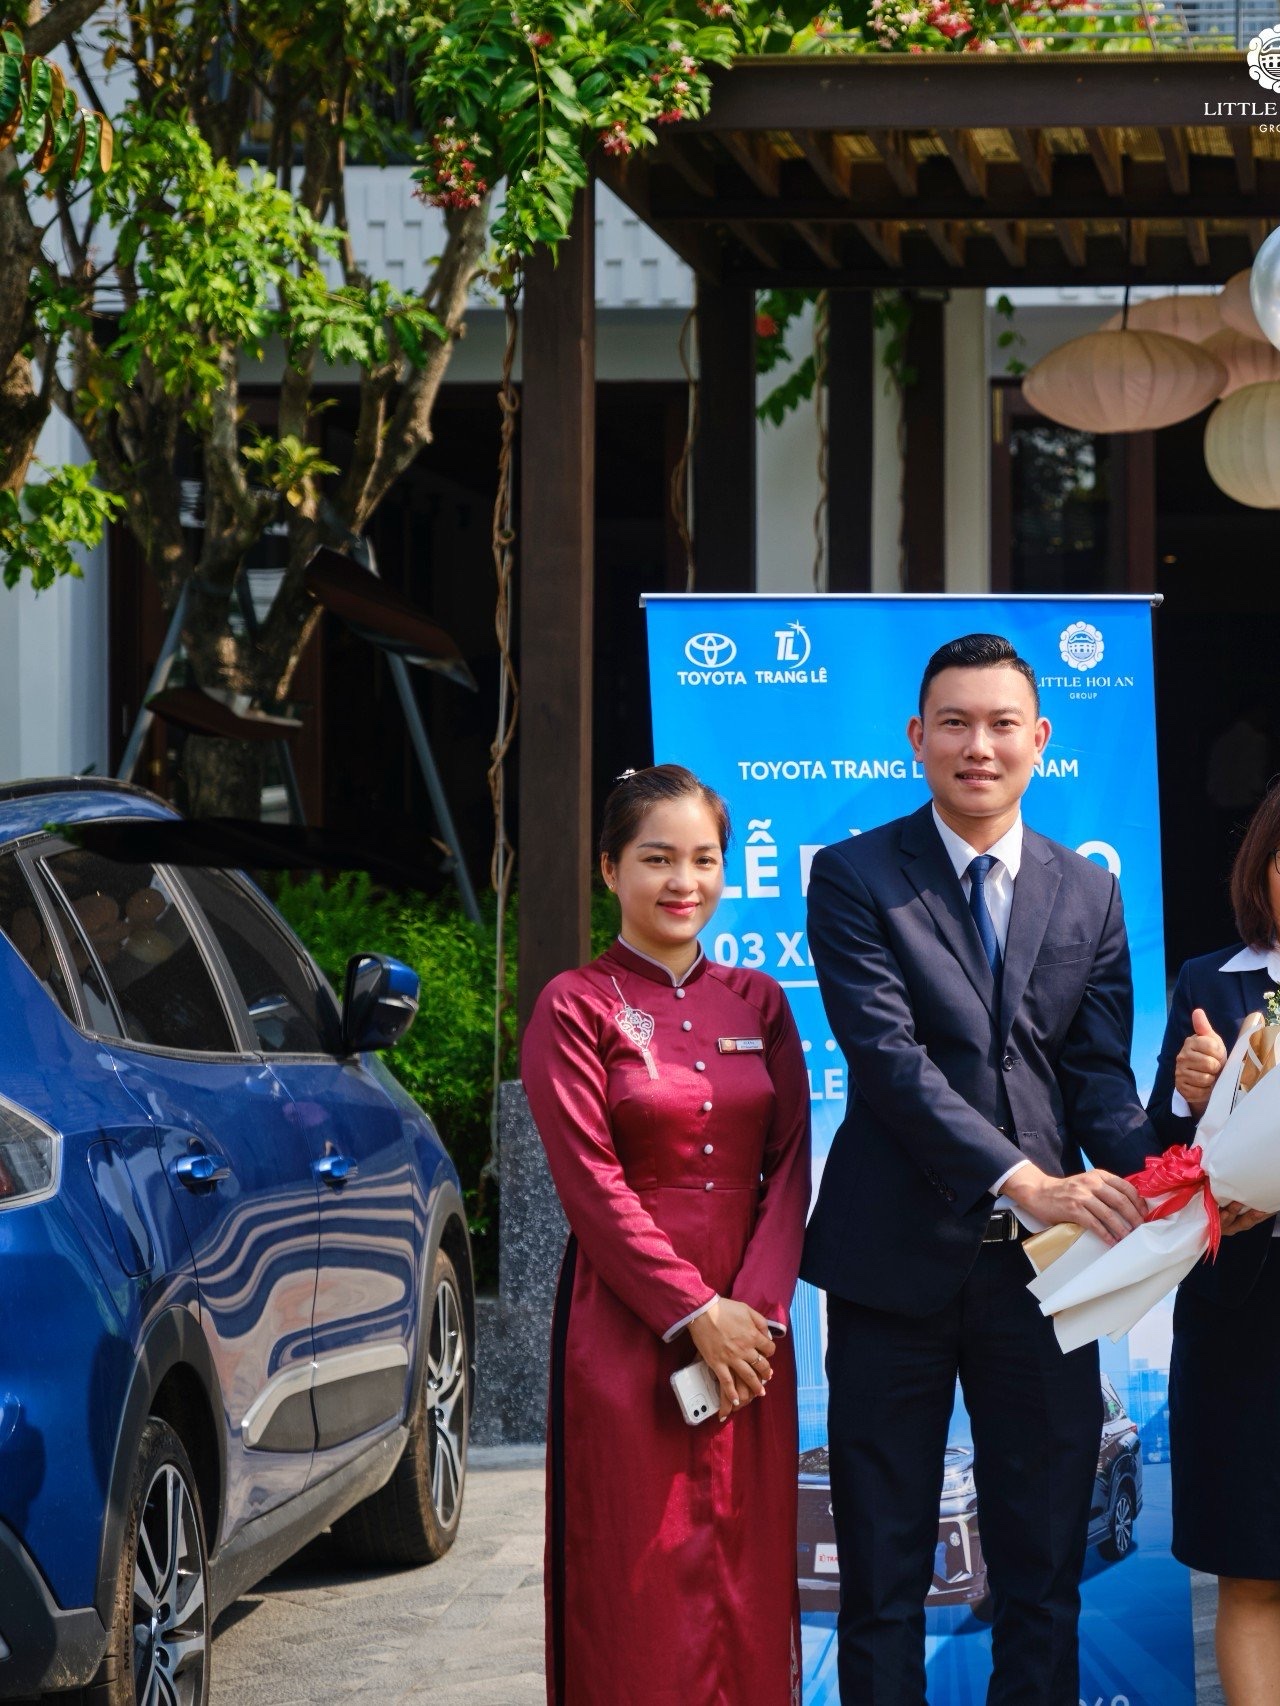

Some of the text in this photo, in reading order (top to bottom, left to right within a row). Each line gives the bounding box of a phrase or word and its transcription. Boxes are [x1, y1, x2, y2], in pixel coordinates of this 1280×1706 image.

[676, 671, 748, 686] TOYOTA
[754, 667, 828, 684] TRANG LÊ
[1086, 676, 1111, 687] HOI
[1114, 676, 1134, 687] AN
[1069, 692, 1098, 700] GROUP
[738, 760, 827, 781] TOYOTA
[831, 760, 907, 779] TRANG
[912, 760, 925, 779] L
[714, 931, 815, 968] 03 X
